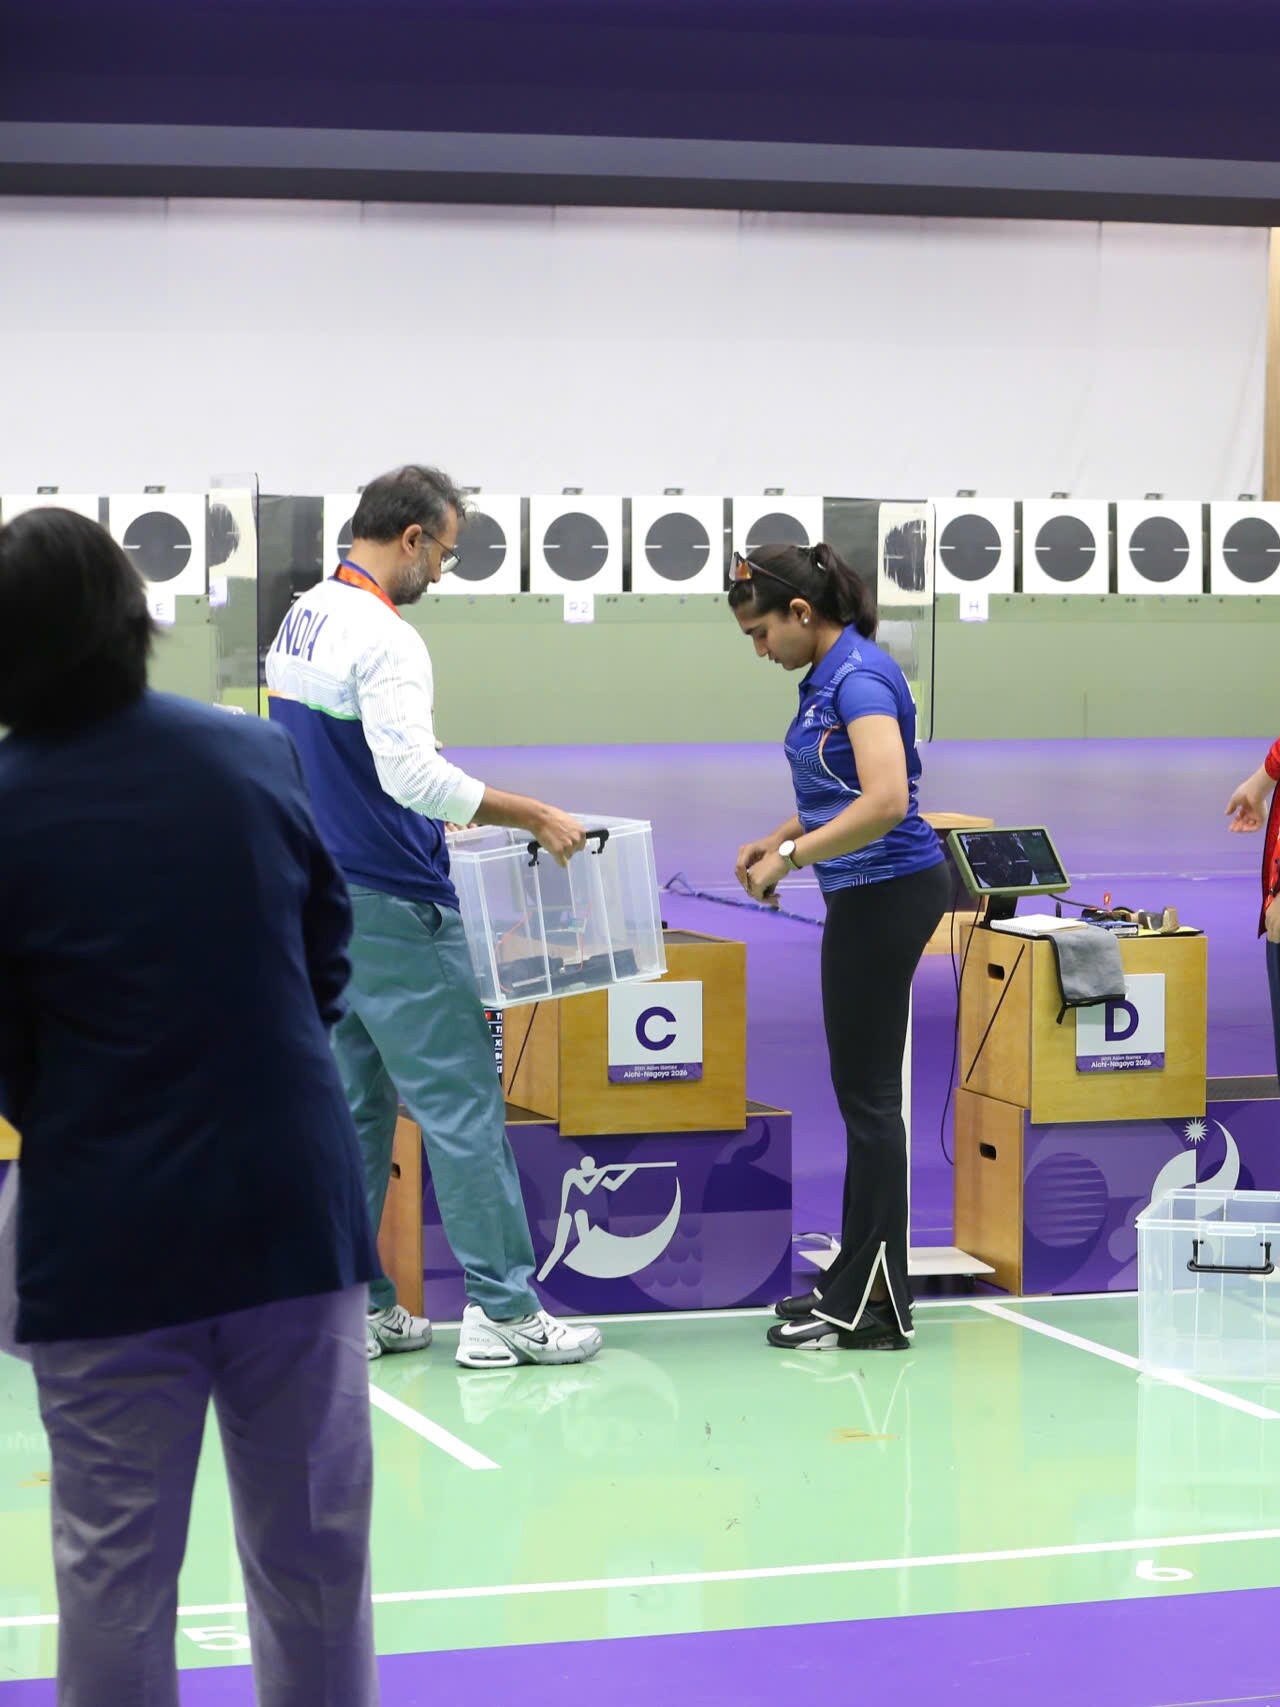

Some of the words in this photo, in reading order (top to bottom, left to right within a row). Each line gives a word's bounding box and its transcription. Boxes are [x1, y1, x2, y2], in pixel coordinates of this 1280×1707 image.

[635, 1006, 677, 1051] C
[1104, 999, 1139, 1042] D
[671, 1069, 688, 1077] 2026
[1135, 1059, 1152, 1067] 2026
[1136, 1559, 1194, 1582] 6
[182, 1625, 251, 1651] 5
